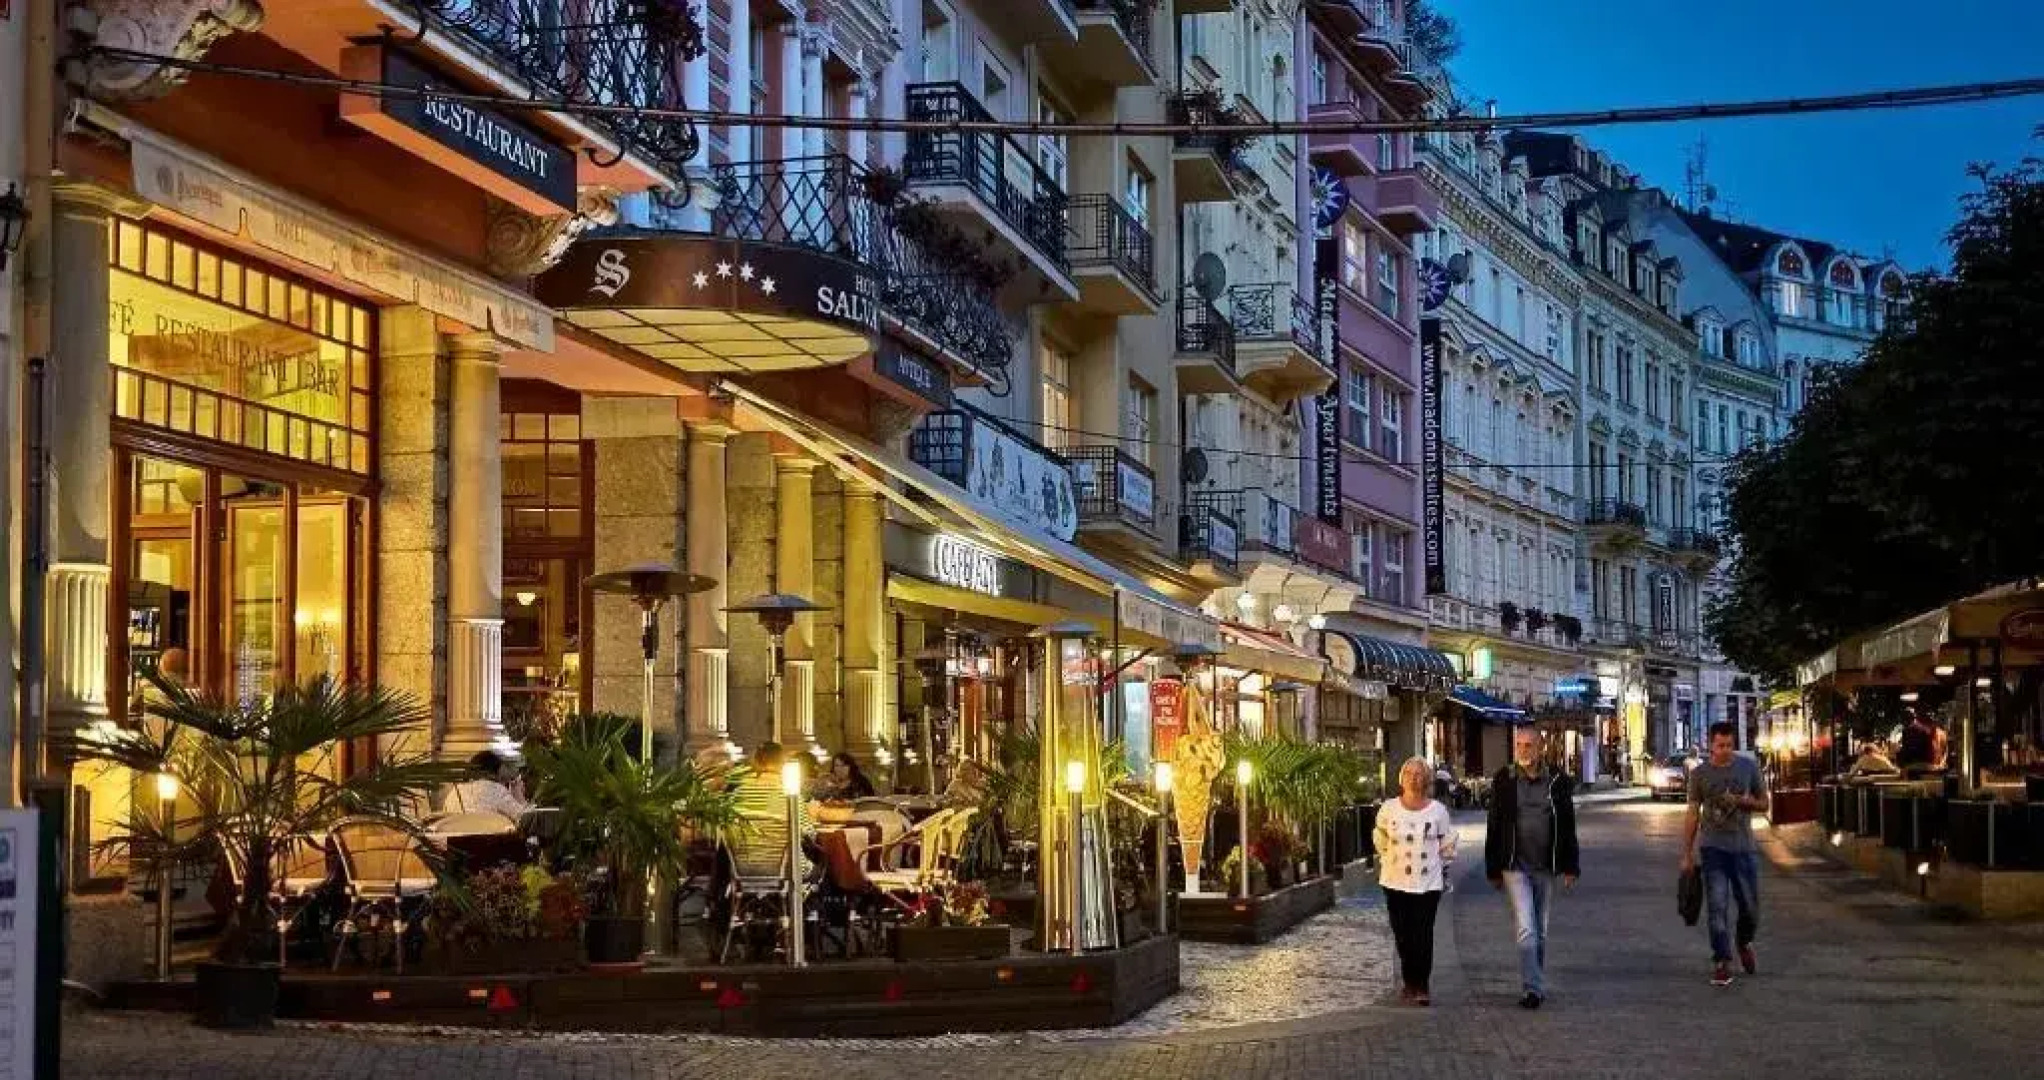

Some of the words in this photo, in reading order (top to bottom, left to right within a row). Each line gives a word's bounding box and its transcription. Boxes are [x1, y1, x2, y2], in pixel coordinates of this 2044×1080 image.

[424, 92, 548, 178] RESTAURANT
[590, 249, 630, 298] S
[155, 313, 288, 382] RESTAURANT
[304, 360, 338, 397] BAR
[1317, 394, 1338, 516] Apartments
